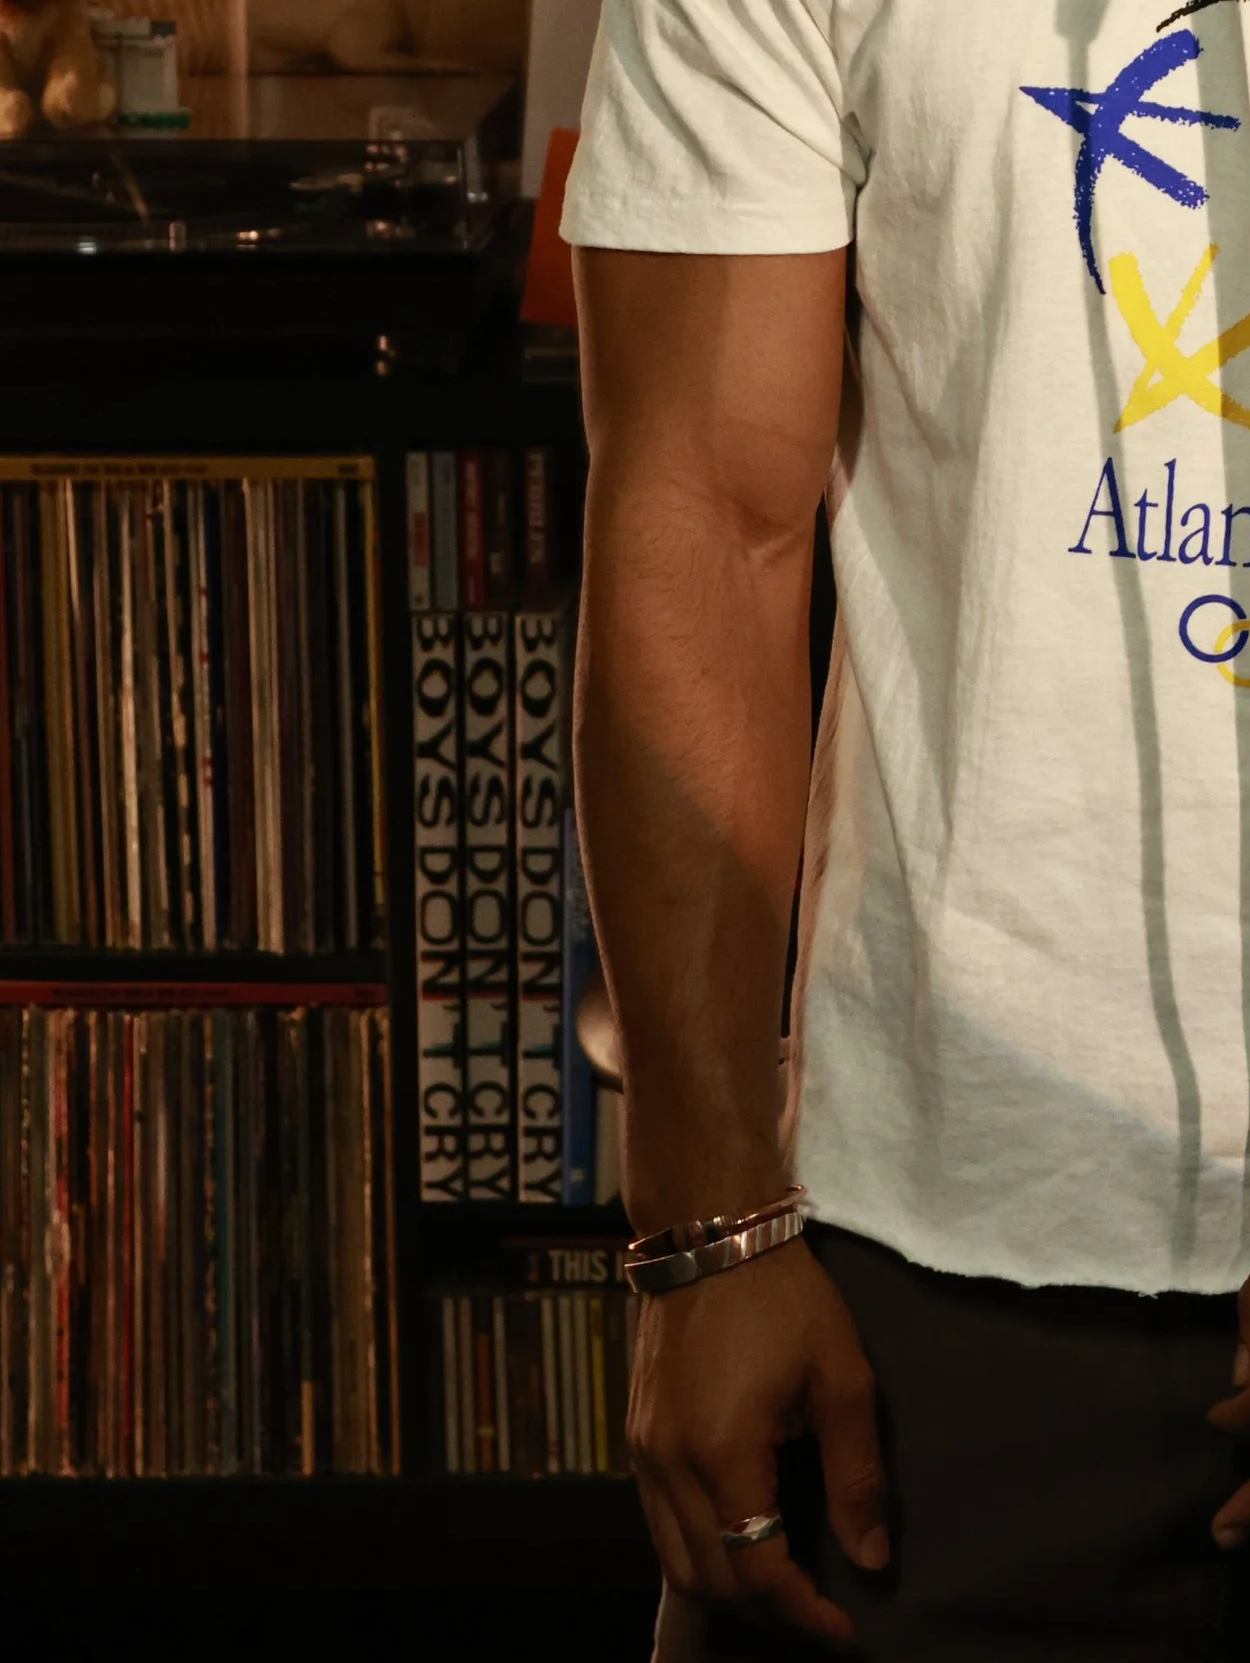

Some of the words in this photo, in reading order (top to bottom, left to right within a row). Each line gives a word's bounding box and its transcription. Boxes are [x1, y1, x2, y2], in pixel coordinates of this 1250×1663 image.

[416, 616, 457, 829] BOYS
[464, 616, 510, 828] BOYS
[520, 617, 559, 829] BOYS
[423, 1081, 464, 1199] CRY
[467, 1080, 510, 1197] CRY
[523, 1082, 563, 1200] CRY
[547, 1248, 609, 1283] THIS
